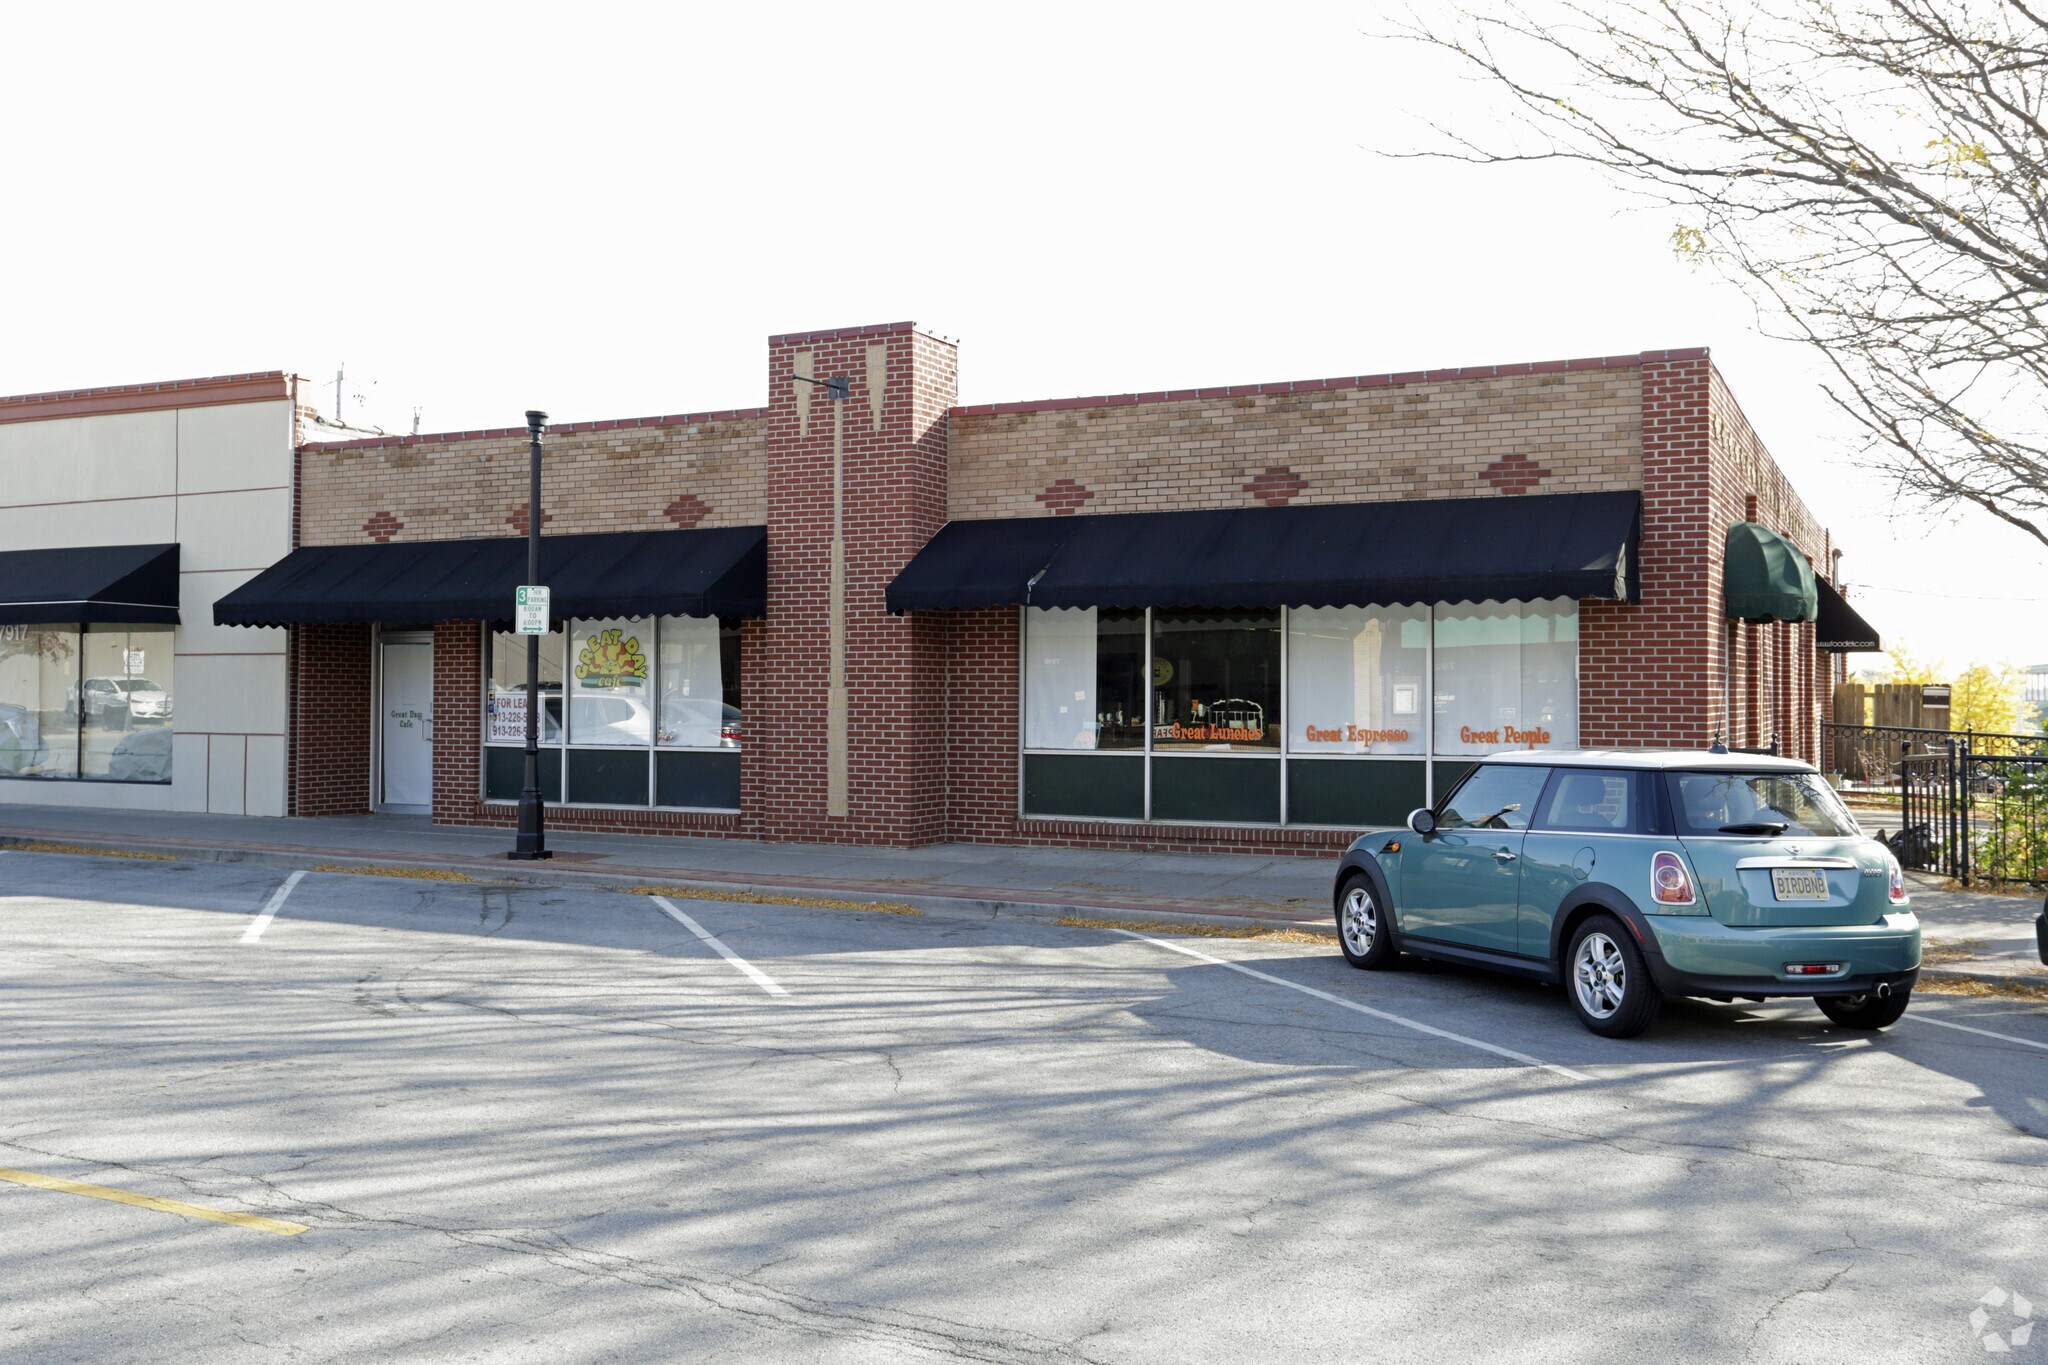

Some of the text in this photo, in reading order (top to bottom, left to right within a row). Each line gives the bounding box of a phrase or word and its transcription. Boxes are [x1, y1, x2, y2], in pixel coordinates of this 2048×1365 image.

[518, 590, 526, 602] 3
[575, 629, 647, 679] GREAT DAY
[496, 698, 511, 708] FOR
[390, 710, 423, 720] Great Day
[1172, 721, 1262, 741] Great Lunches
[1306, 724, 1409, 748] Great Espresso
[1460, 725, 1551, 750] Great People
[1777, 877, 1825, 894] BIRDBNB
